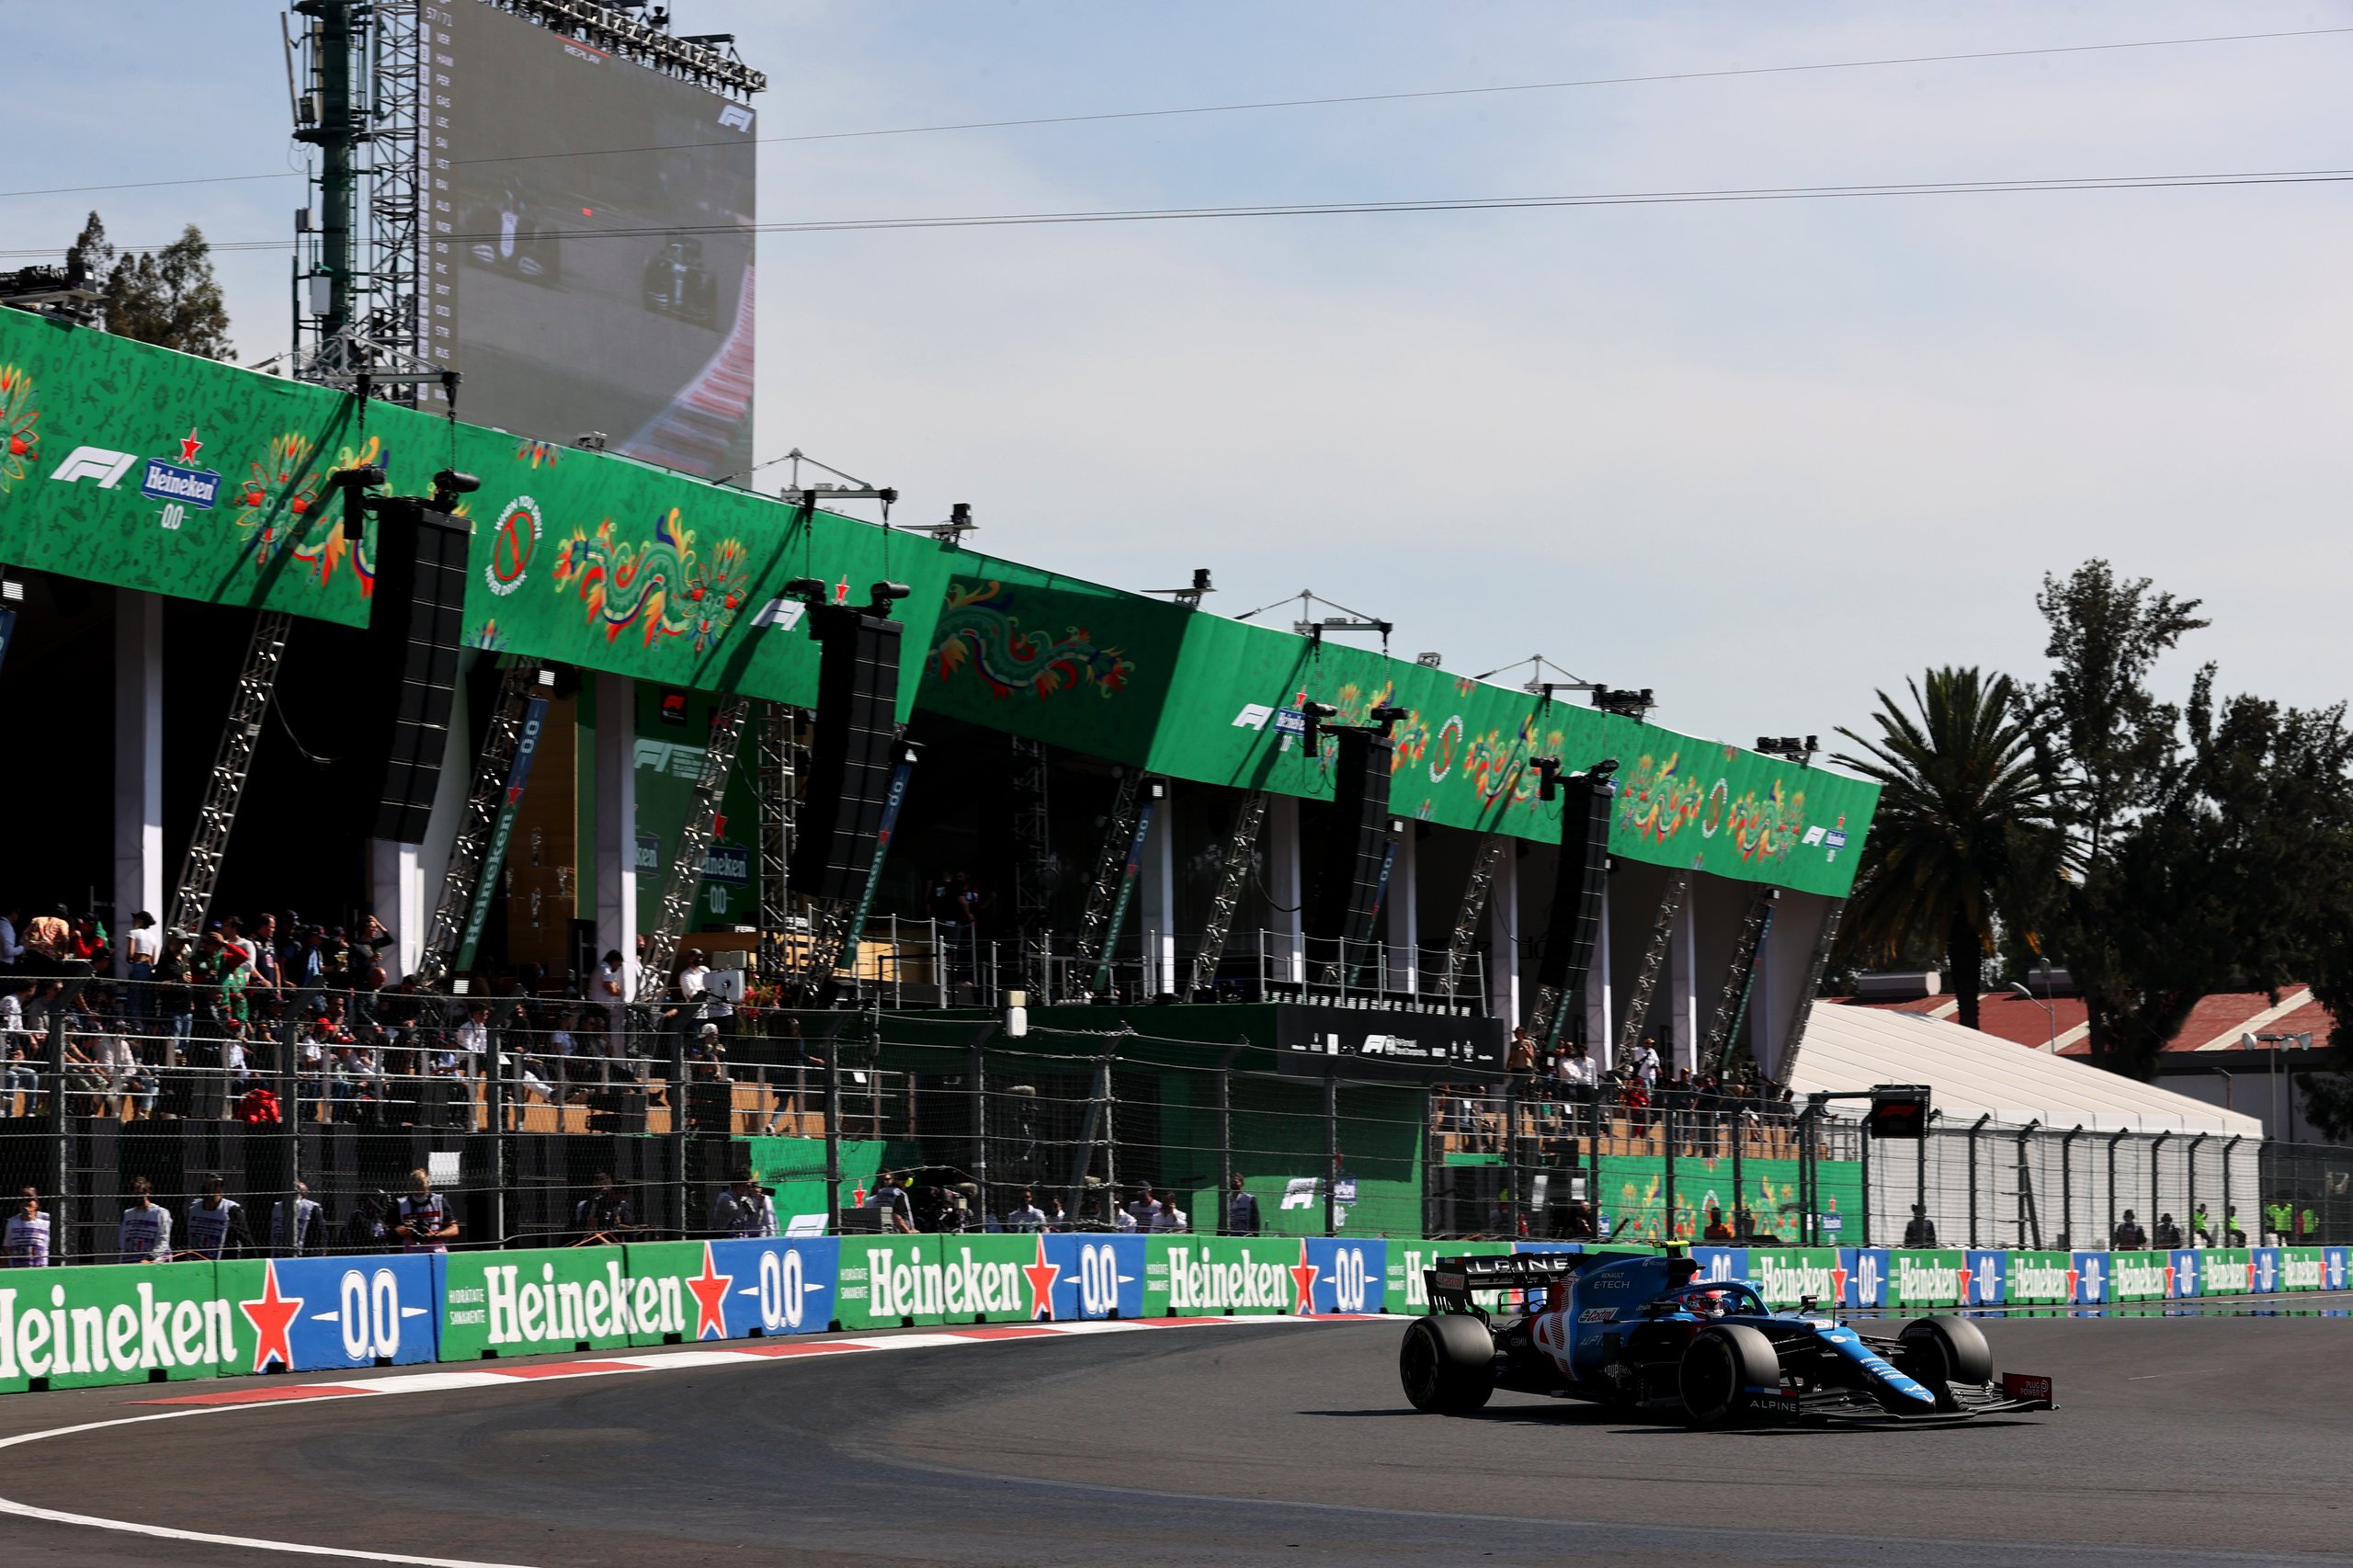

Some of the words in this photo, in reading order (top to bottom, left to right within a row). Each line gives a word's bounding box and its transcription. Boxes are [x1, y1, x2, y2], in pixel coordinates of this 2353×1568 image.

[145, 466, 214, 501] Heineken
[465, 813, 513, 946] Heineken
[692, 848, 747, 878] eineken
[759, 1249, 802, 1330] 0.0
[867, 1246, 1022, 1317] Heineken
[1081, 1244, 1119, 1313] 0.0
[1167, 1247, 1289, 1308] Heineken
[1440, 1275, 1463, 1288] Castrol
[1600, 1272, 1625, 1280] RENAULT
[1760, 1256, 1832, 1302] Heineken
[1899, 1256, 1958, 1301] Heineken
[339, 1268, 400, 1359] 0.0
[483, 1260, 687, 1344] Heineken
[1586, 1308, 1615, 1324] Castrol
[1579, 1335, 1624, 1346] ALPIE
[2020, 1387, 2040, 1396] POWER
[2026, 1381, 2040, 1390] PLUG
[1750, 1400, 1797, 1412] ALPINE
